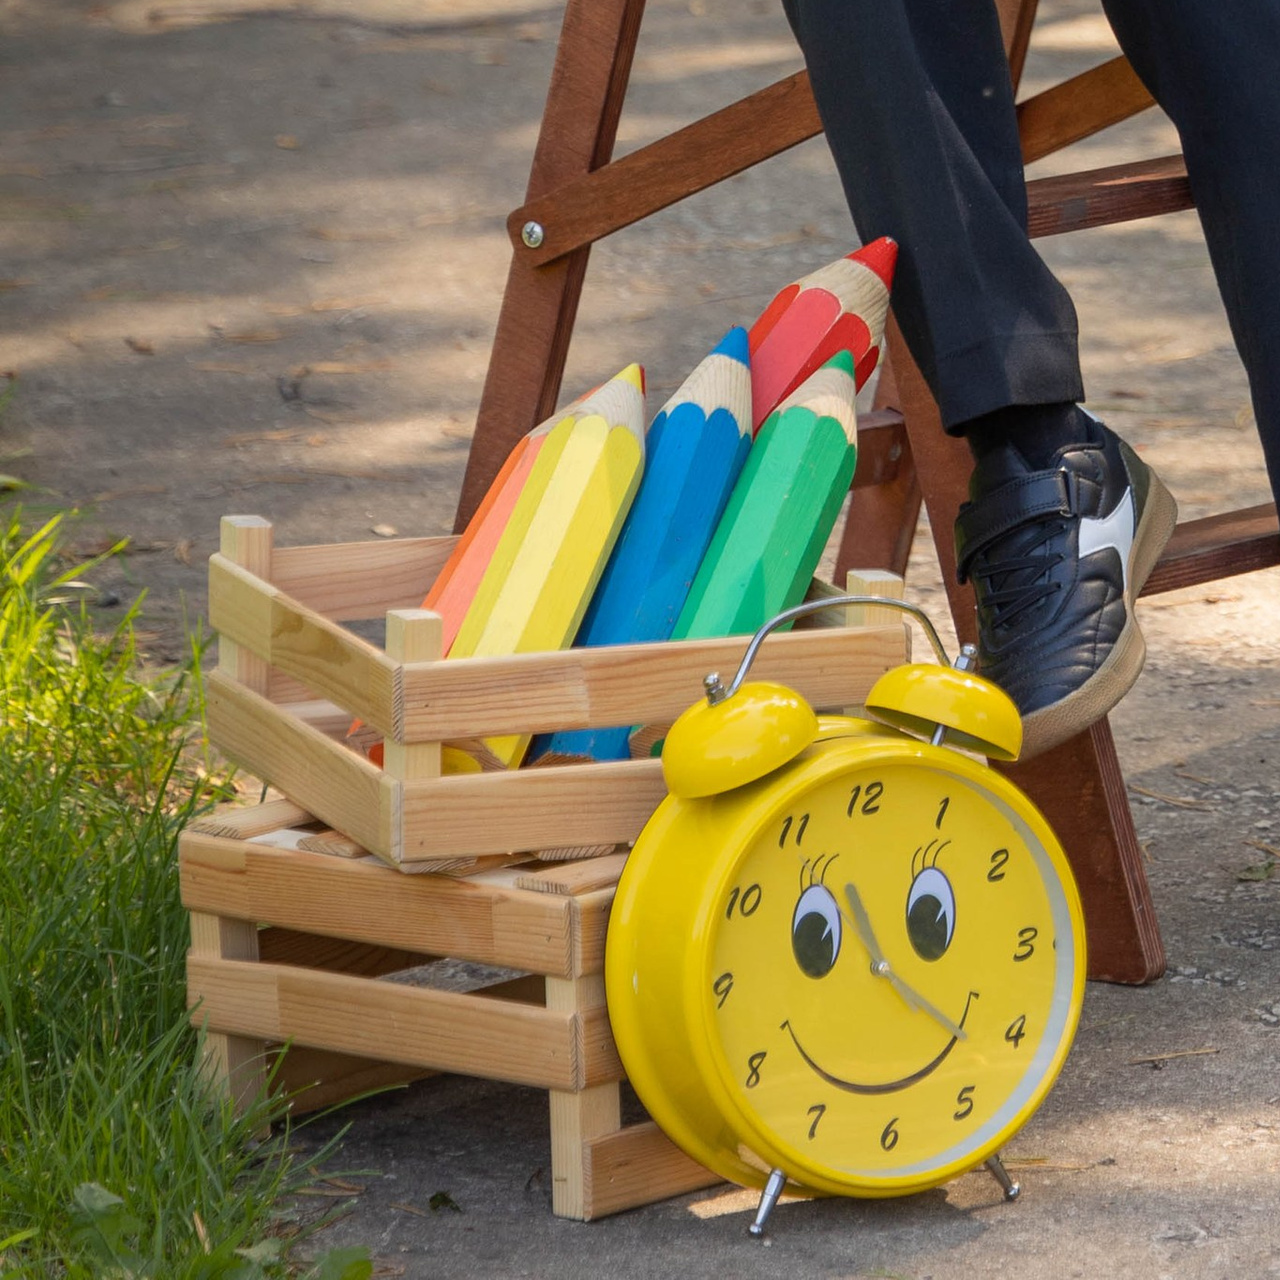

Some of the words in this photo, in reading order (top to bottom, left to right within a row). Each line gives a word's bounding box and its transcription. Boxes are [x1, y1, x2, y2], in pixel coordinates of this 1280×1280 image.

[847, 781, 884, 817] 12
[935, 797, 950, 829] 1
[778, 813, 810, 848] 11
[987, 848, 1009, 882] 2
[726, 883, 762, 920] 10
[1013, 927, 1038, 962] 3
[713, 972, 734, 1009] 9
[1005, 1015, 1026, 1047] 4
[746, 1051, 767, 1086] 8
[954, 1086, 975, 1120] 5
[808, 1104, 826, 1138] 7
[880, 1118, 899, 1150] 6
